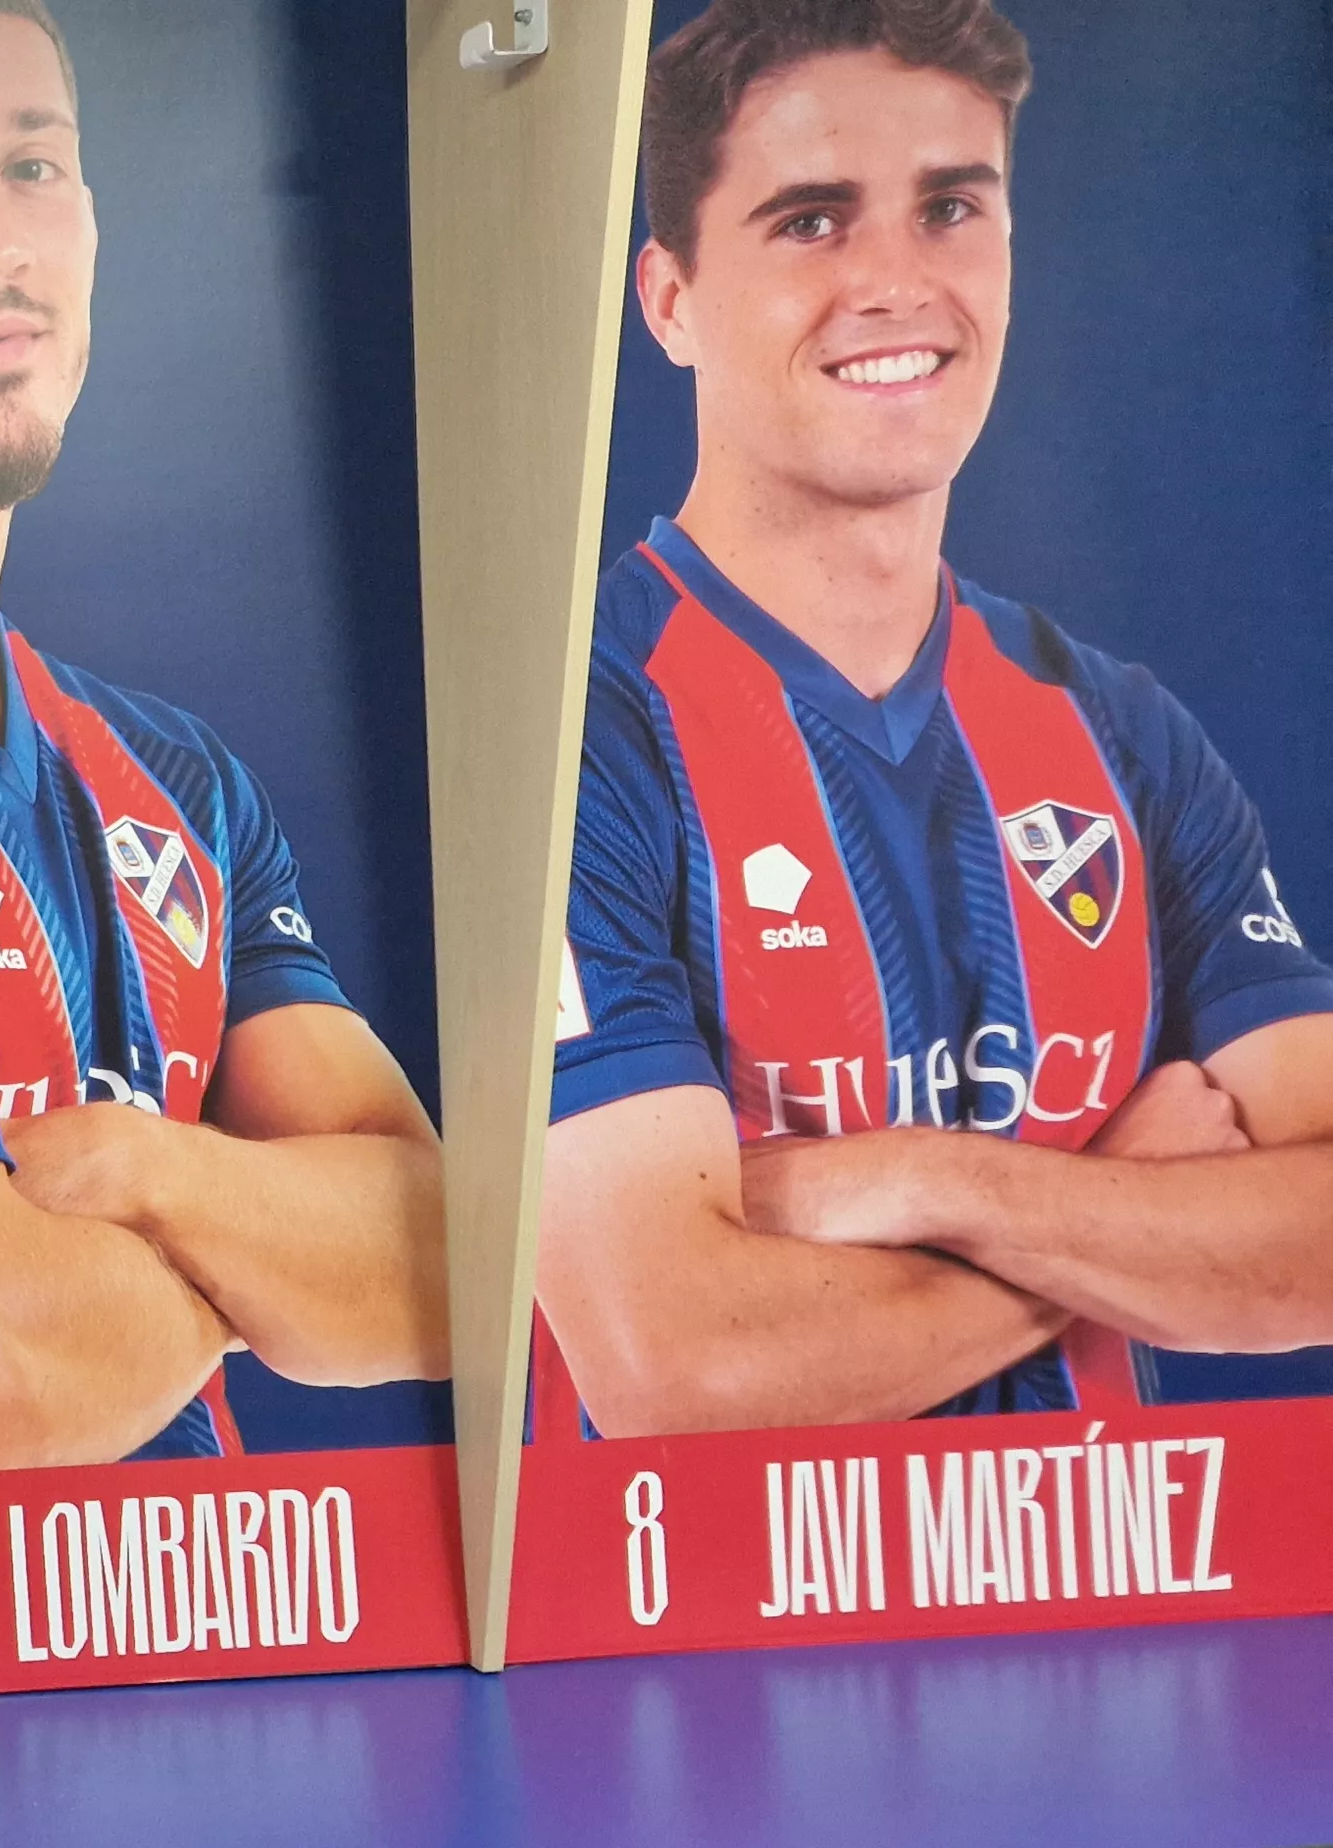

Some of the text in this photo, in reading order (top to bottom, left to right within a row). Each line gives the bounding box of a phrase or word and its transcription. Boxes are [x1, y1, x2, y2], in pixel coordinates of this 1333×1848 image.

[761, 920, 828, 951] soka
[11, 1485, 359, 1663] LOMBARDO
[626, 1422, 1233, 1626] 8 JAVI MARTÍNEZ
